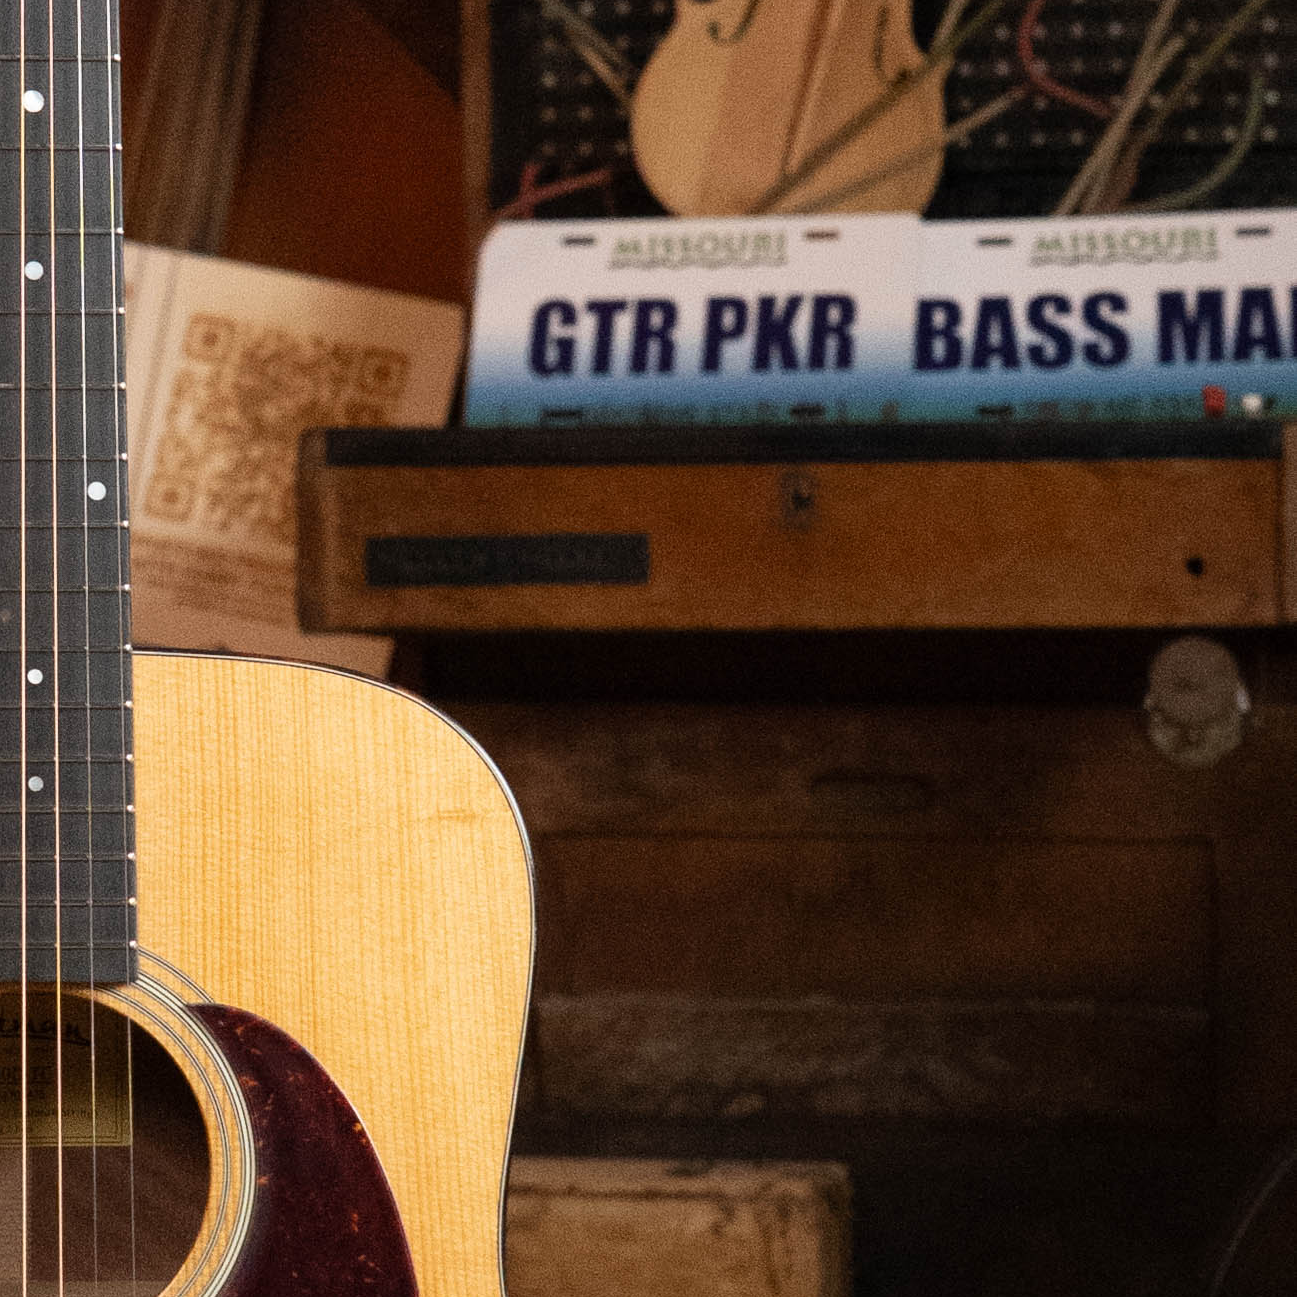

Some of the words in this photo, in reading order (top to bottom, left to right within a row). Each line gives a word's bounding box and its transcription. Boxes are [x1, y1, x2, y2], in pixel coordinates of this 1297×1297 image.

[611, 229, 788, 263] MISSOURI
[1032, 226, 1218, 259] MISSOURI
[529, 295, 679, 376] GTR
[701, 293, 859, 373] PKR
[913, 290, 1132, 371] BASS
[1156, 285, 1297, 364] MA
